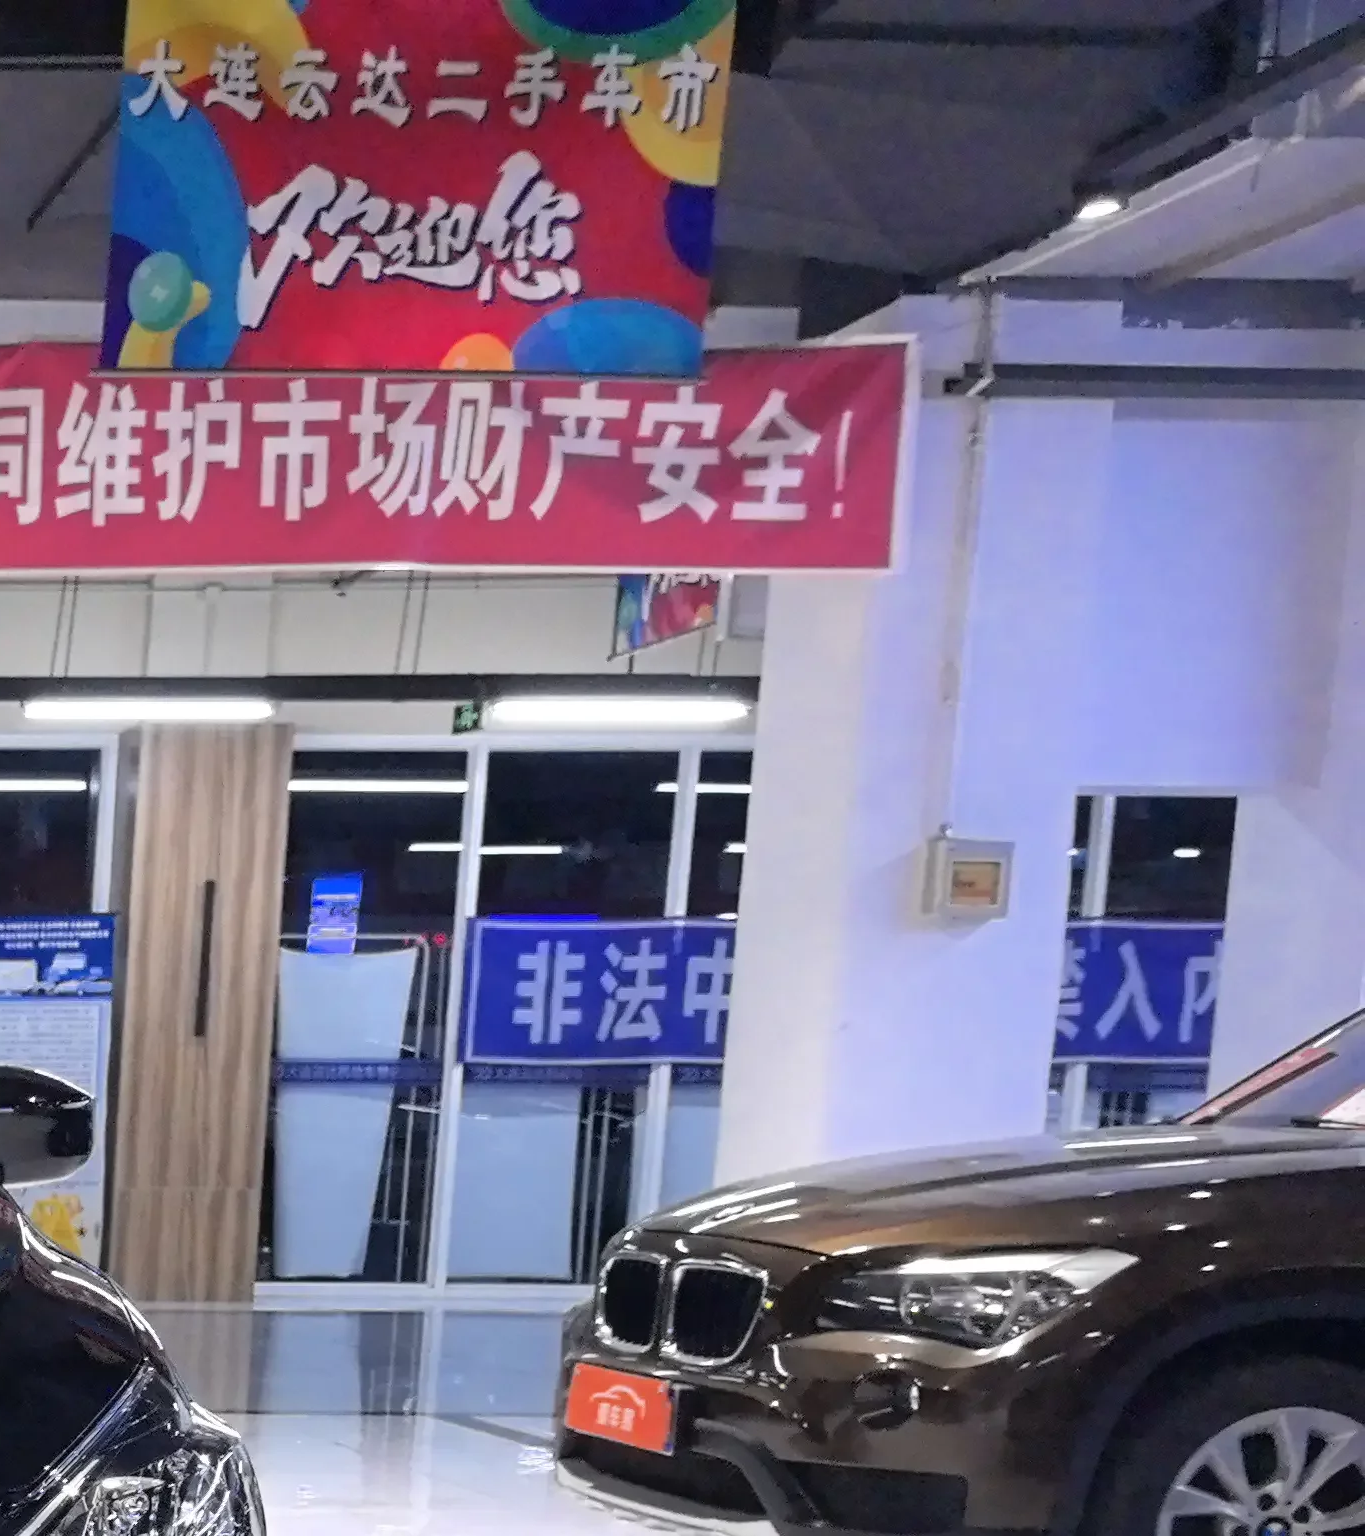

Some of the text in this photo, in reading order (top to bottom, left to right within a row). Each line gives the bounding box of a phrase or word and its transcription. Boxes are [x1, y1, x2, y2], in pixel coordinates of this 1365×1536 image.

[129, 40, 719, 132] 大连云达二手车市
[236, 150, 582, 329] 欢迎您
